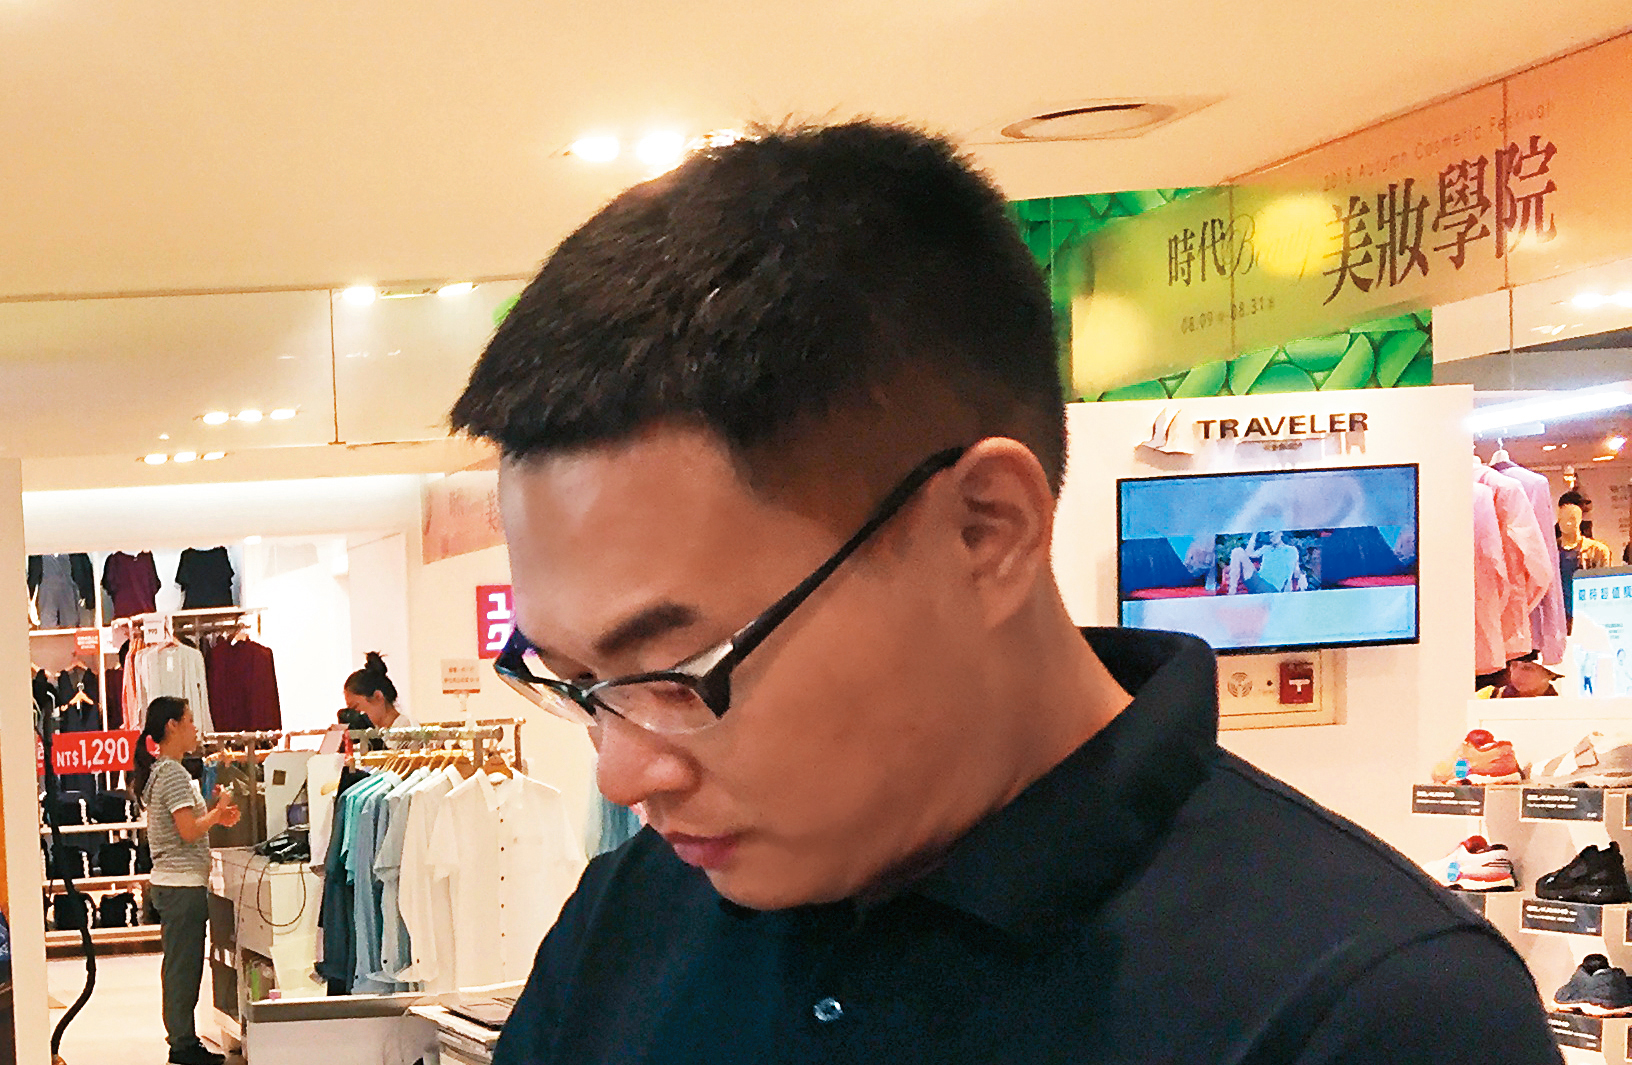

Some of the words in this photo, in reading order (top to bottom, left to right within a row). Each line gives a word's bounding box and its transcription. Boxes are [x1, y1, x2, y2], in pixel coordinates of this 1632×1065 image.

[1168, 217, 1230, 287] 時代
[1323, 135, 1558, 307] 美妝學院
[1196, 412, 1369, 440] TRAVELER
[56, 736, 130, 769] NT$1,290
